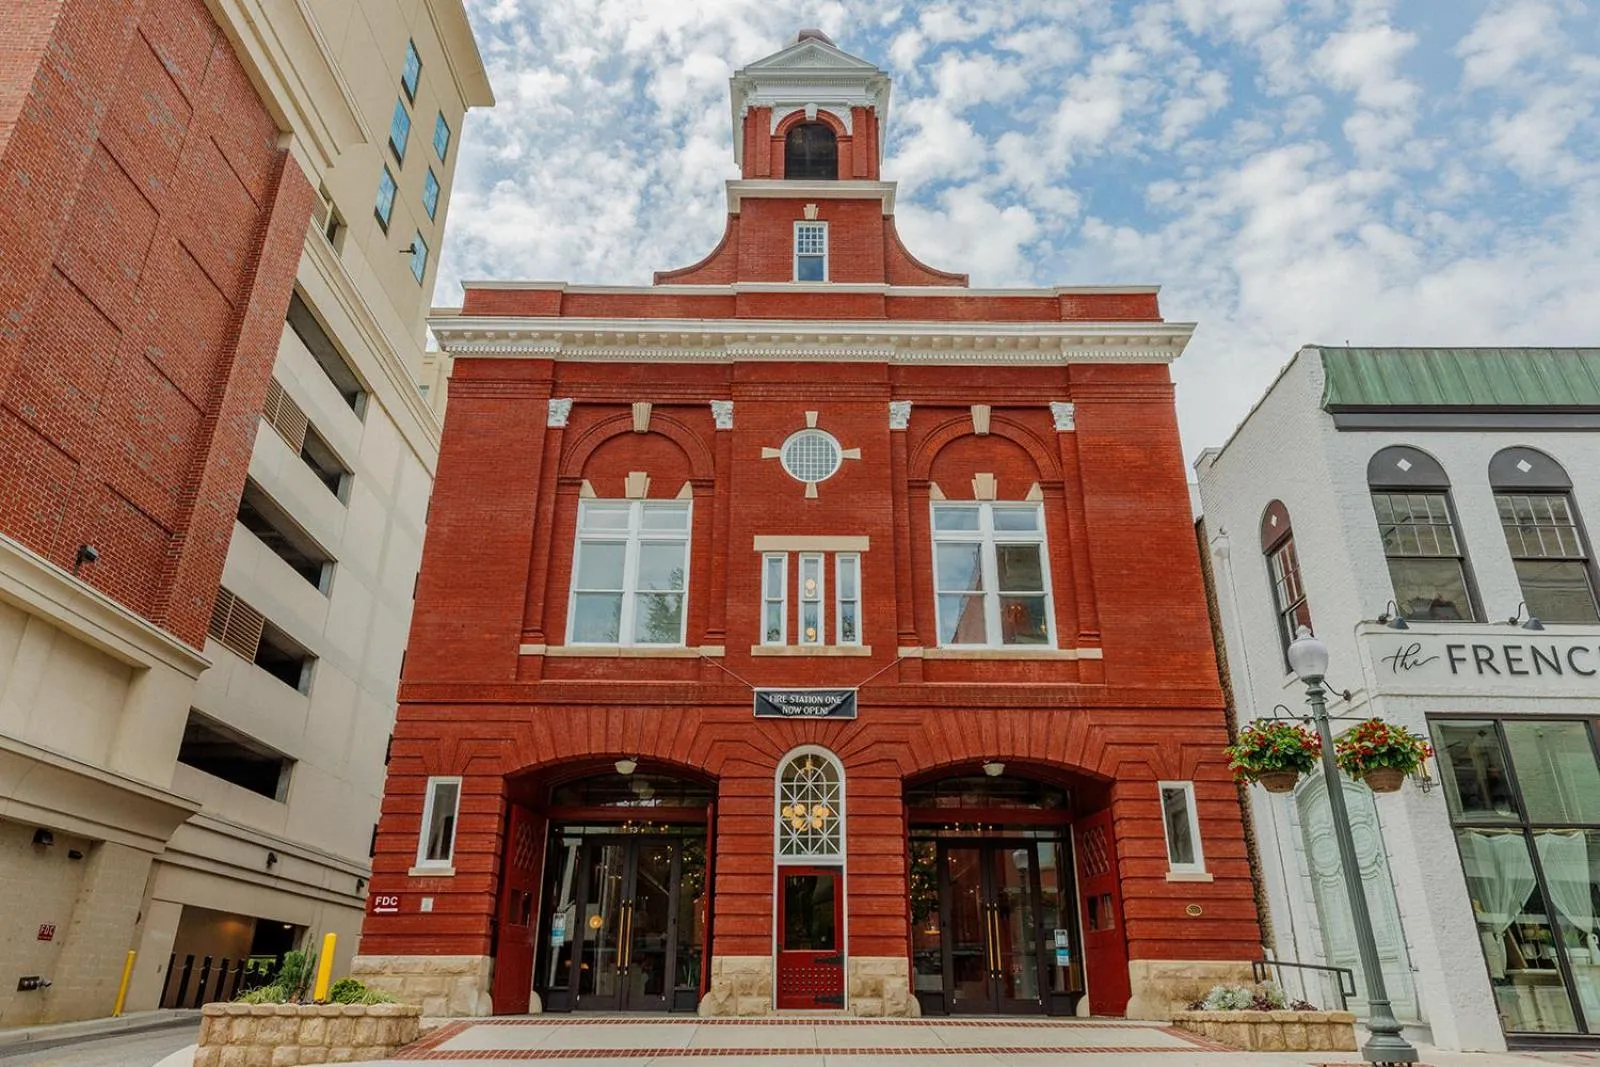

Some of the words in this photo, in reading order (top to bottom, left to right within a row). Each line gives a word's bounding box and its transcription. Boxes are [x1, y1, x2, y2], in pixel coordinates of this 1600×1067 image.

[1382, 642, 1440, 674] the
[1446, 644, 1600, 676] FRENC
[769, 695, 787, 703] FIRE
[790, 695, 823, 704] STATION
[825, 696, 842, 704] ONE
[782, 706, 801, 715] NOW
[803, 706, 828, 715] OPEN!
[375, 896, 398, 905] FDC
